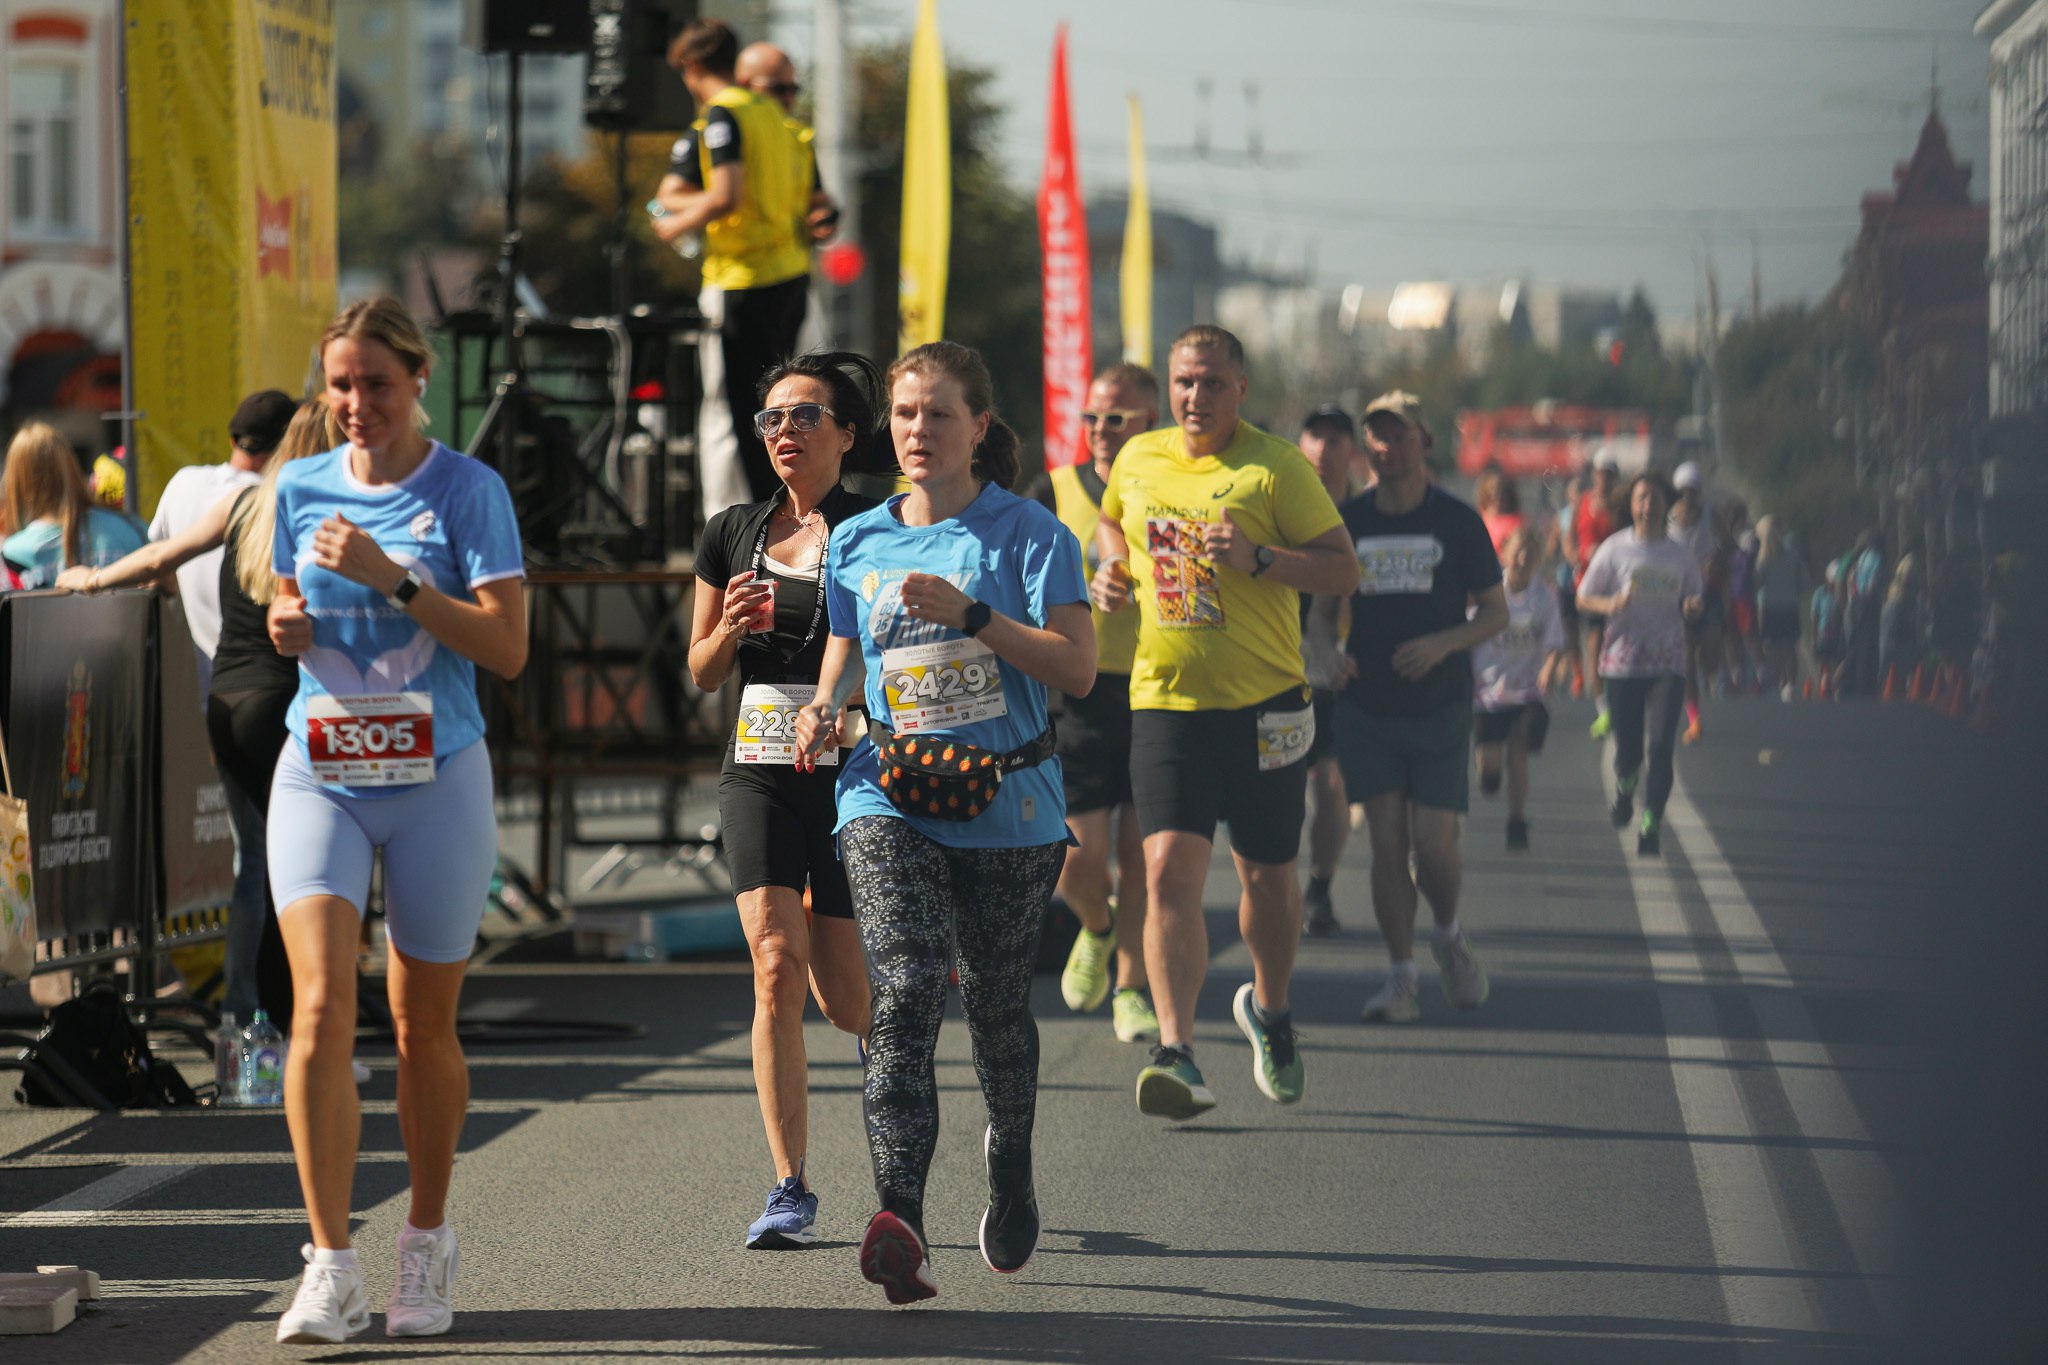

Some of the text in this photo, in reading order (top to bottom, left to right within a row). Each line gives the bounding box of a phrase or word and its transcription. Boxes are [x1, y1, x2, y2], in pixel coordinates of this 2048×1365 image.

[755, 532, 766, 552] BONA
[751, 552, 760, 570] FIDE
[818, 567, 826, 588] BONA
[816, 588, 824, 606] FIDE
[811, 607, 822, 628] BONA
[879, 602, 895, 616] 08
[937, 643, 965, 653] ВОРОТА
[895, 663, 987, 704] 2429
[745, 709, 798, 738] 228
[321, 720, 416, 755] 1305
